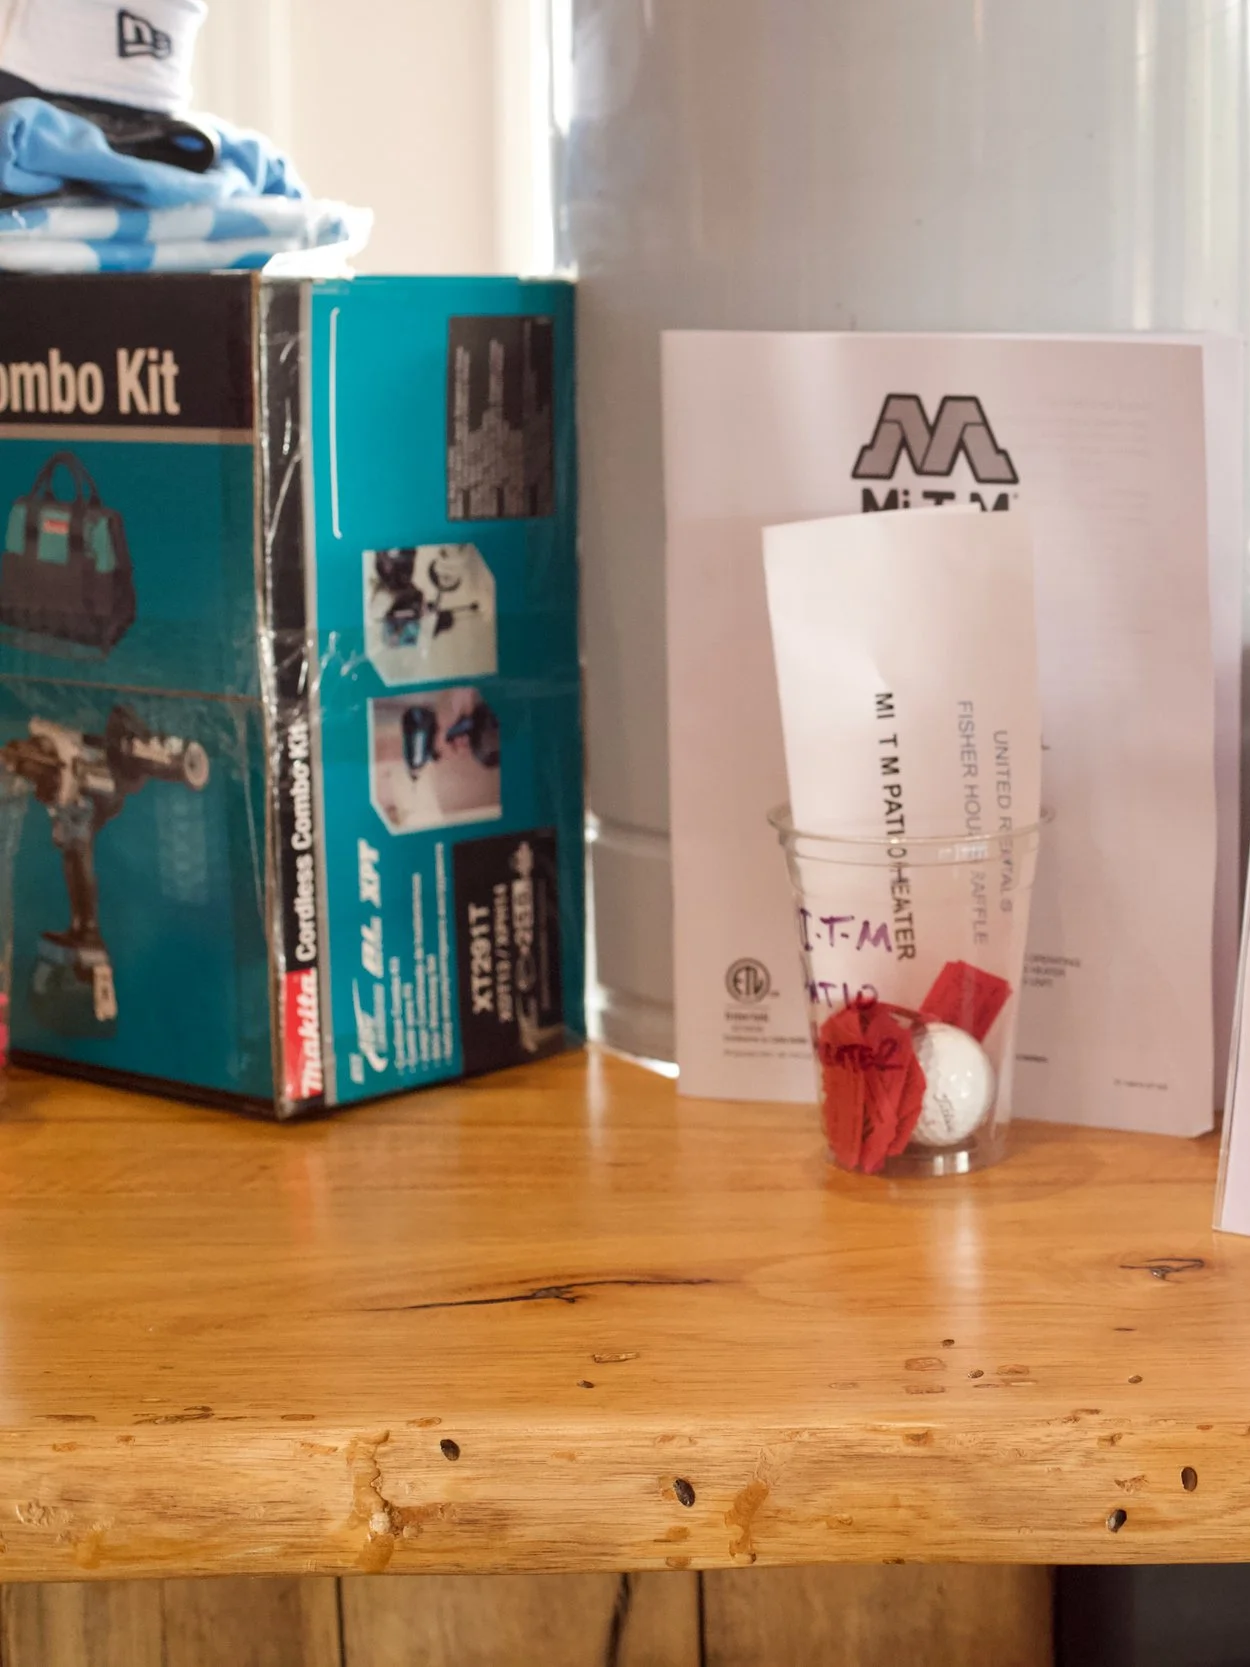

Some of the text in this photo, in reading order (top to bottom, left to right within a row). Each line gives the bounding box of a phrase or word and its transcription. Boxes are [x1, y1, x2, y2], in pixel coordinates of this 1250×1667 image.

[116, 347, 181, 415] Kit
[875, 692, 895, 720] MI
[879, 733, 898, 749] T
[957, 700, 980, 778] FISHER
[880, 756, 900, 775] M
[993, 730, 1013, 810] UNITED
[290, 759, 313, 850] Combo
[295, 853, 317, 962] Cordless
